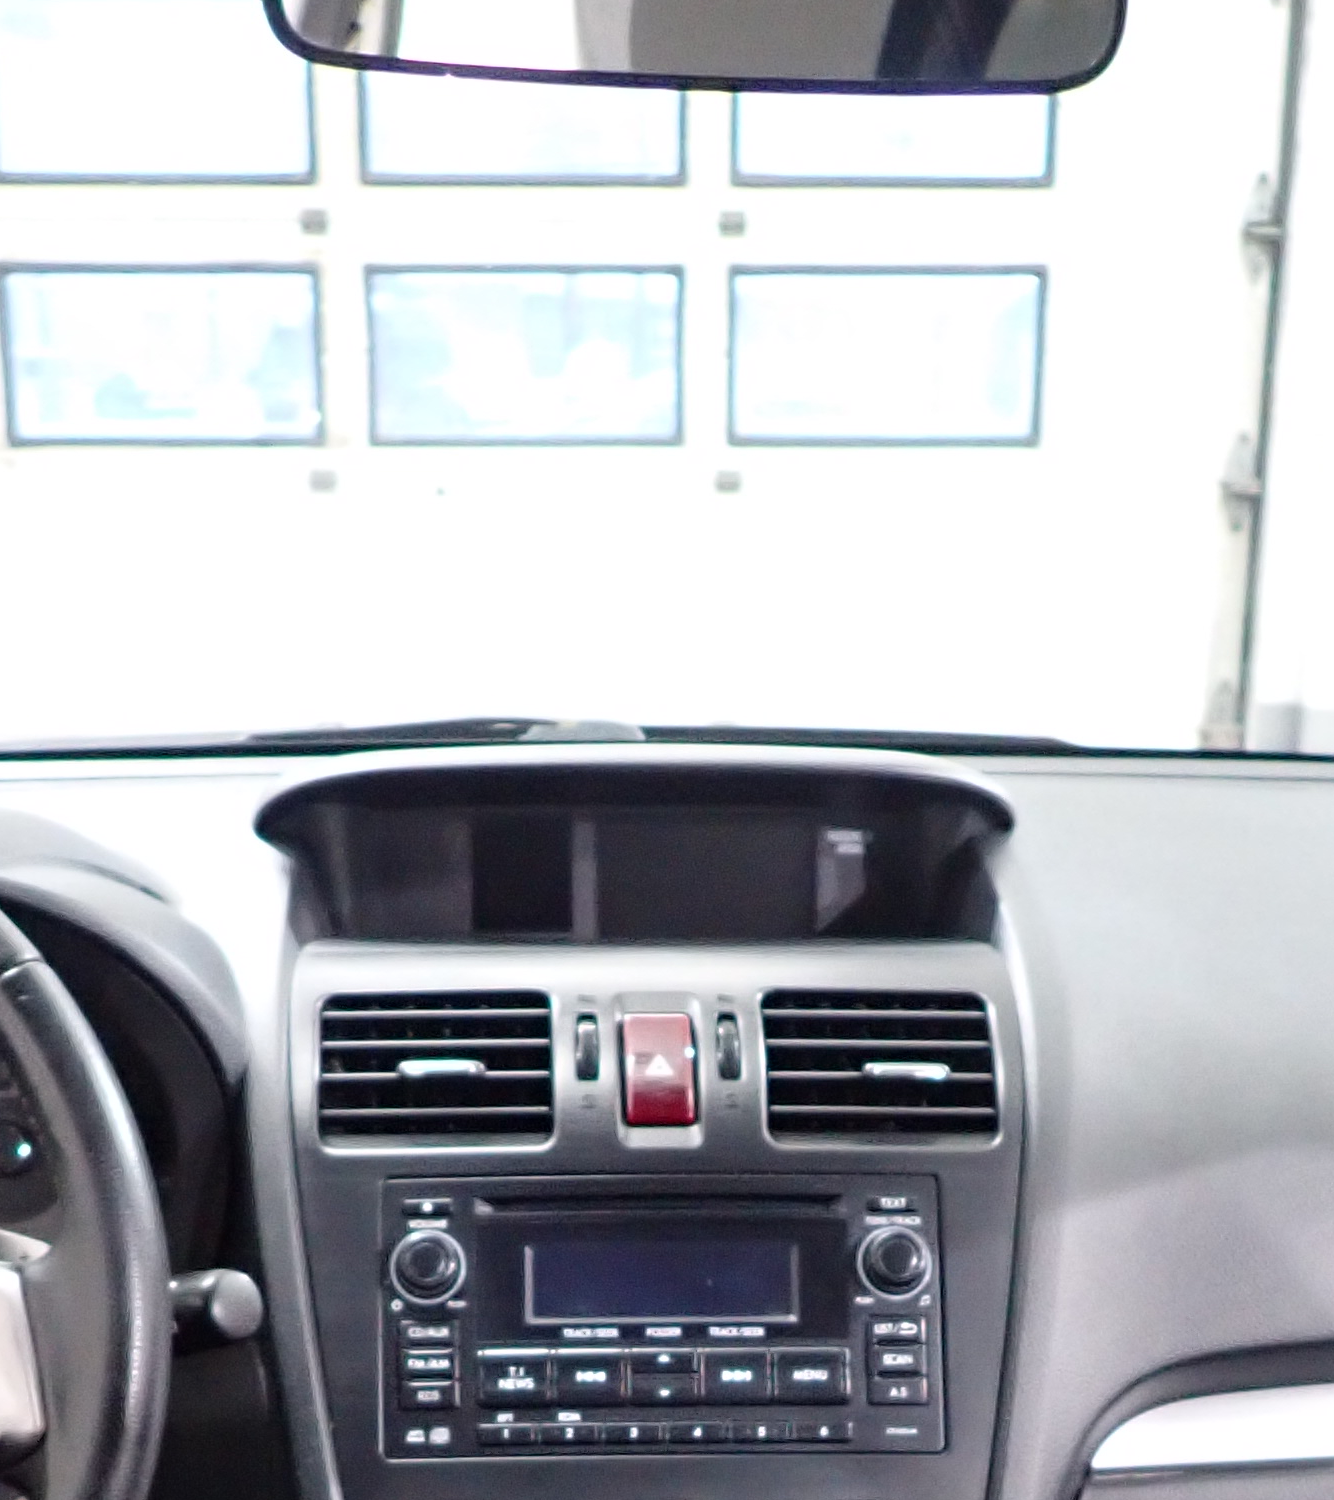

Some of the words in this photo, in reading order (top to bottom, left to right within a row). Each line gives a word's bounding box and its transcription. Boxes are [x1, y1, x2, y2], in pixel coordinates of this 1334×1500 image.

[792, 1369, 829, 1381] MENU
[497, 1378, 535, 1390] NEWS
[564, 1427, 574, 1440] 2
[629, 1427, 639, 1439] 3
[693, 1426, 703, 1438] 4
[757, 1425, 767, 1438] 5
[819, 1425, 830, 1438] 6
